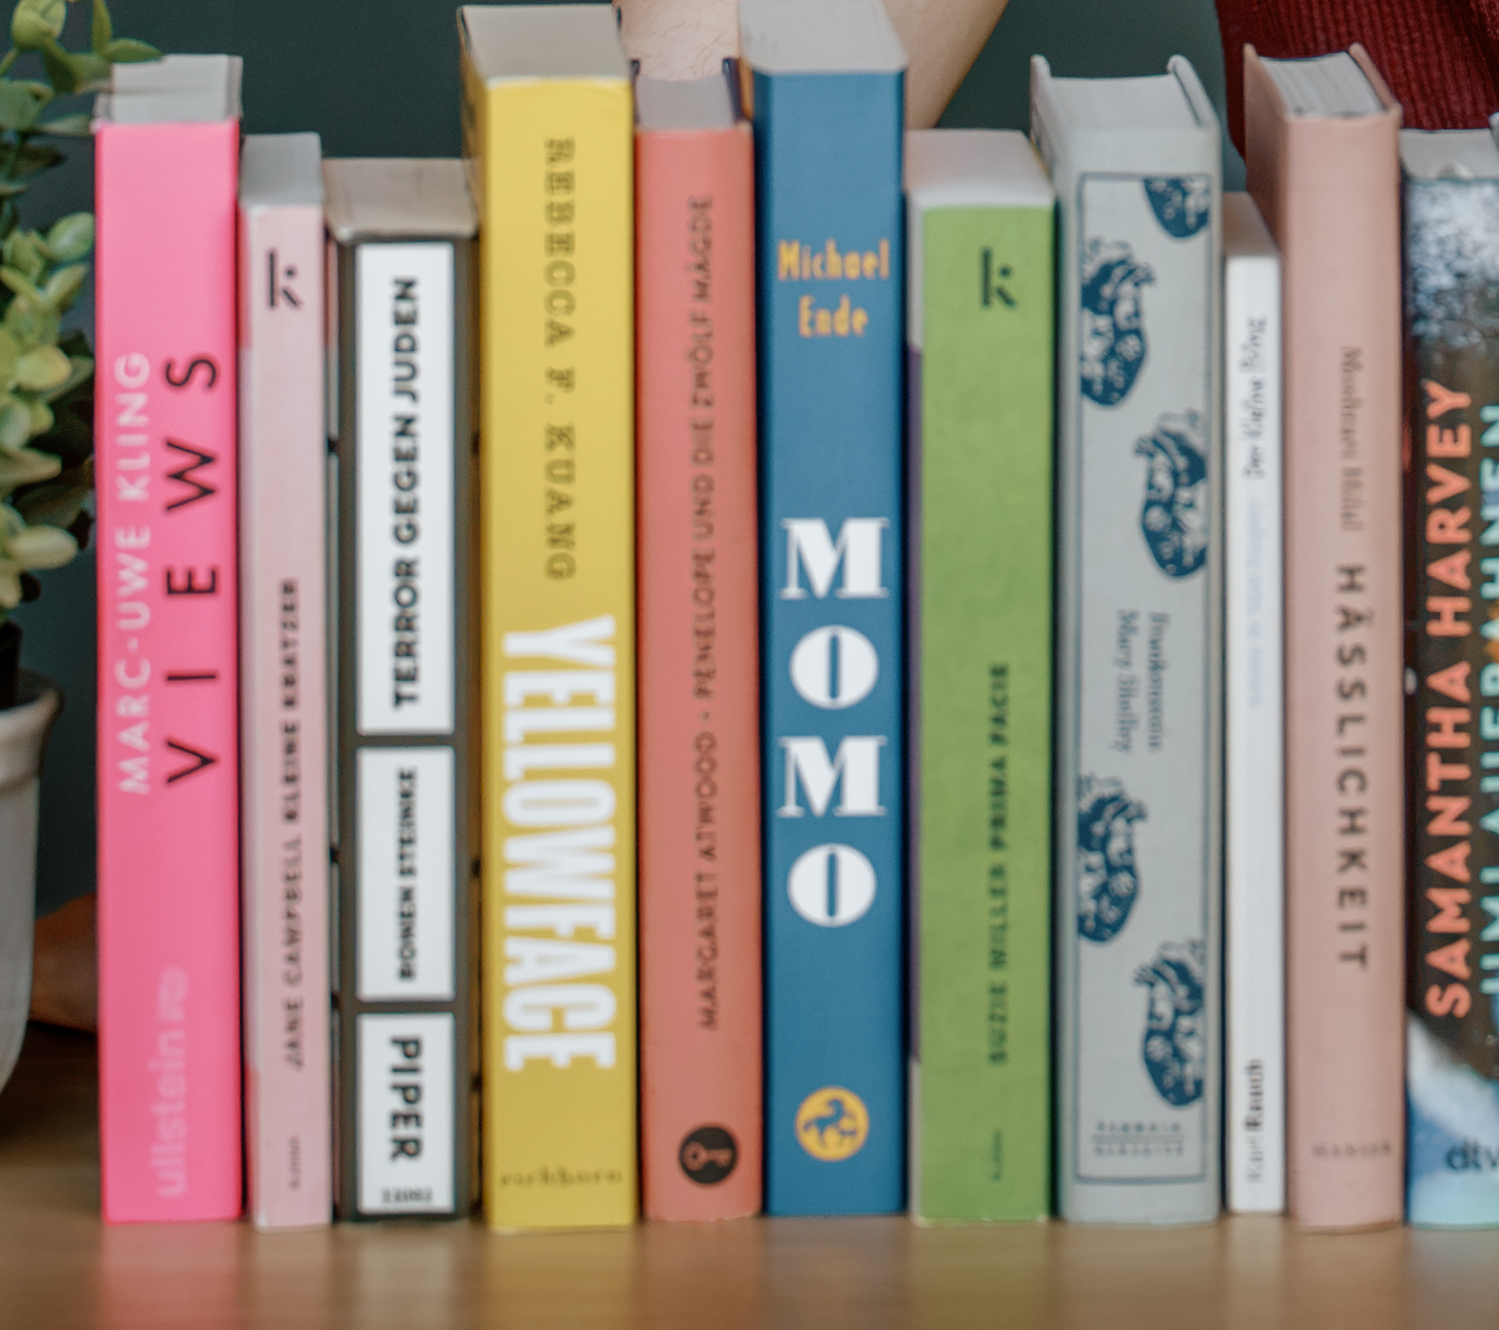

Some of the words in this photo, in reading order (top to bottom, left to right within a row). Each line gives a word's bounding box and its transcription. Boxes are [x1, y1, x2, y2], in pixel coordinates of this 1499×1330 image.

[544, 138, 573, 345] REBECCA
[686, 196, 714, 301] MÄGDE
[778, 240, 889, 283] Michael
[394, 276, 420, 403] JUDEN
[688, 310, 716, 408] ZWÖLF
[799, 296, 868, 337] Ende
[116, 353, 150, 502] KLING
[544, 367, 573, 404] F.
[693, 418, 717, 464] DIE
[394, 412, 420, 552] GEGEN
[544, 424, 573, 582] KUANG
[693, 474, 717, 540] UND
[1425, 381, 1472, 638] HARVEY
[165, 355, 218, 785] VIEWS
[694, 549, 718, 698] PENELOPE
[116, 523, 152, 797] MARC-UWE
[279, 579, 299, 708] KRATZER
[394, 562, 420, 710] TERROR
[1113, 610, 1139, 669] Mary
[1145, 612, 1169, 751] Frankenstein
[776, 517, 889, 928] MOMO
[988, 664, 1009, 745] FACIE
[1335, 564, 1372, 971] HÄSSLICHKEIT
[280, 720, 301, 822] KLEINE
[399, 766, 417, 875] STEINKE
[695, 731, 719, 860] ATWOOD
[988, 756, 1009, 851] PRIMA
[502, 617, 617, 1073] YELLOWFACE
[1425, 659, 1472, 1017] SAMANTHA
[281, 833, 302, 985] CAMPBELL
[399, 883, 417, 981] RONEN
[695, 871, 719, 1029] MARGARET
[988, 863, 1009, 970] MILLER
[281, 996, 304, 1071] JANE
[988, 982, 1009, 1065] SUZIE
[150, 1027, 185, 1199] ullstein
[388, 1035, 422, 1161] PIPER
[1244, 1059, 1265, 1131] Rauch
